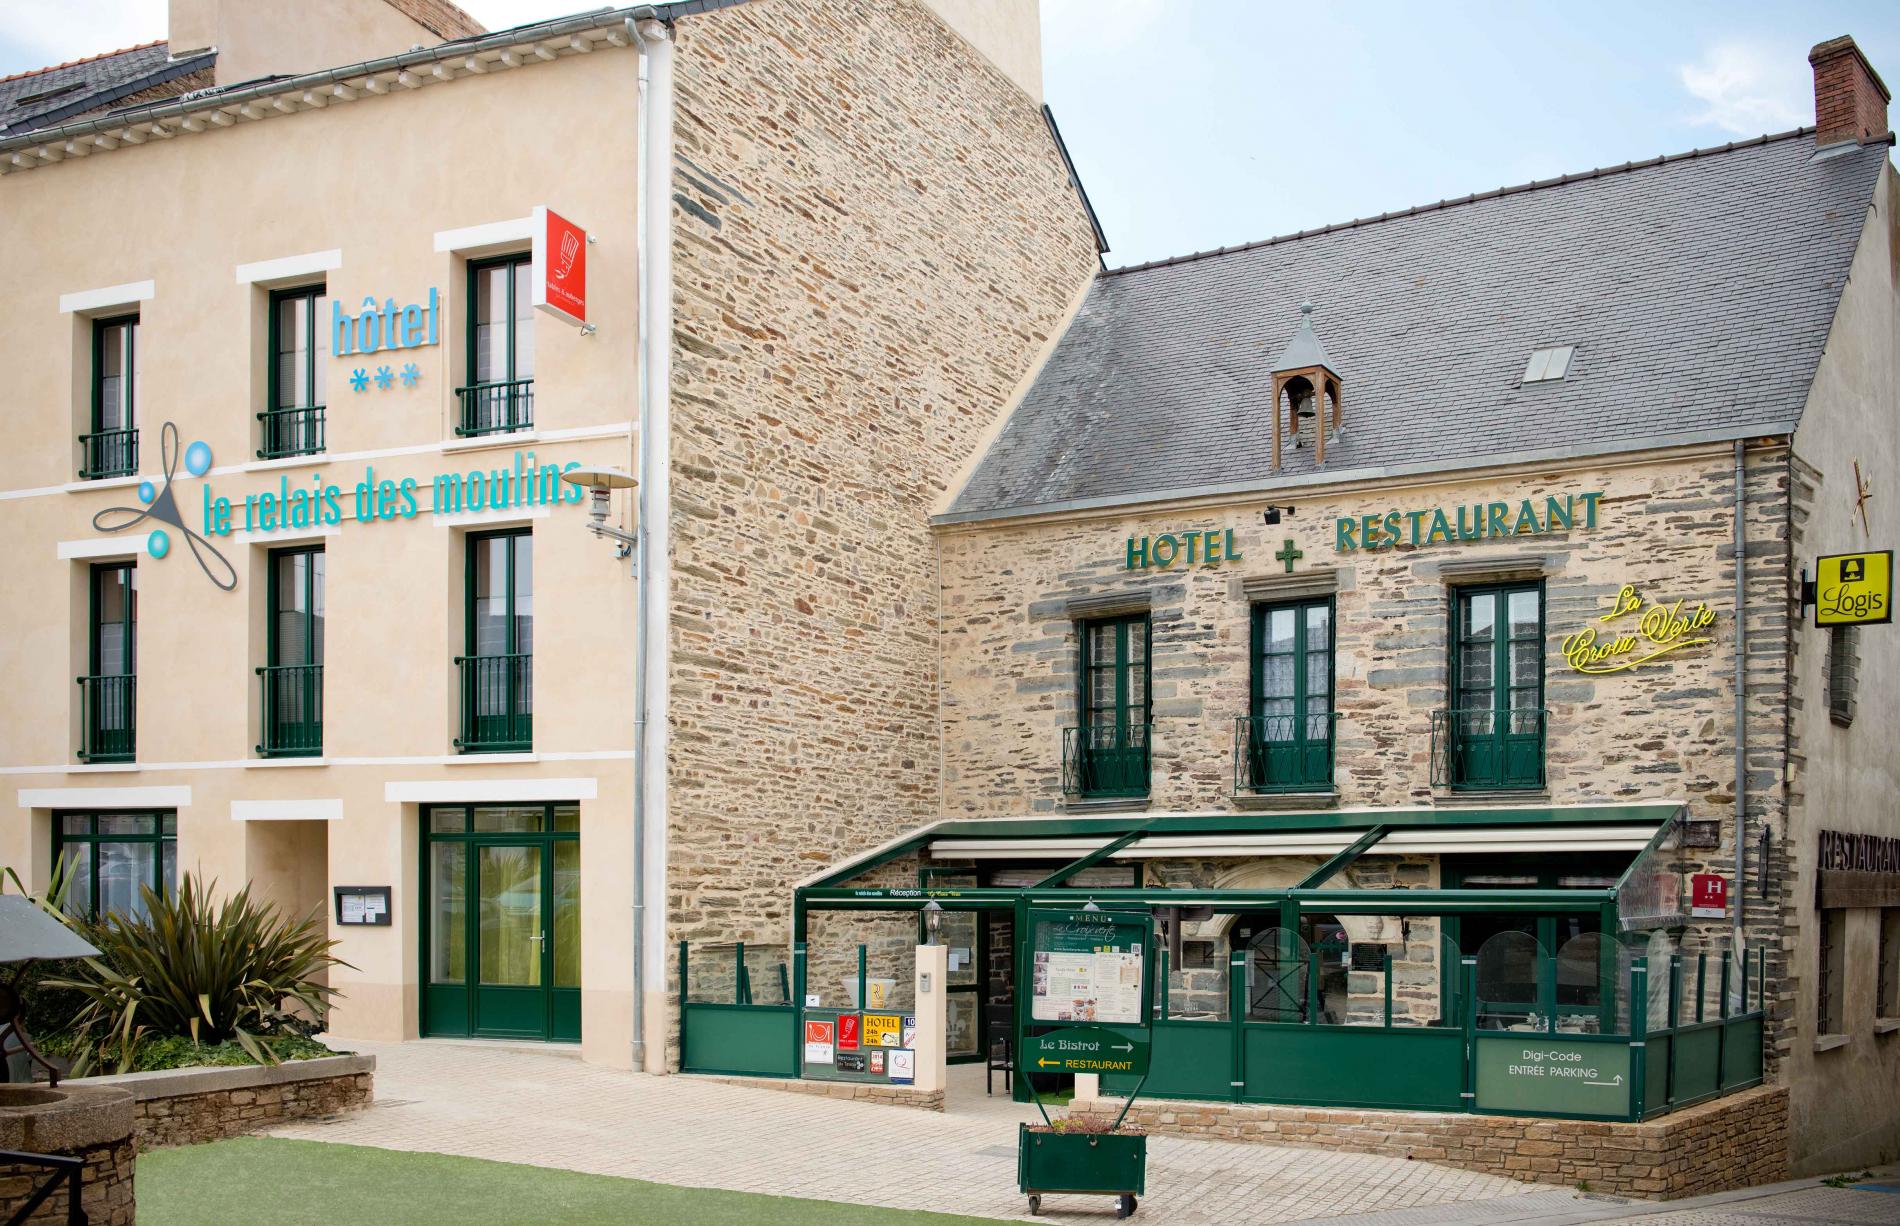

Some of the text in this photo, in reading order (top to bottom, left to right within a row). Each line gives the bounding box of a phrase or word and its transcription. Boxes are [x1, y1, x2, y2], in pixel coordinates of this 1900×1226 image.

[332, 287, 438, 357] hôtel
[203, 451, 583, 536] le relais des moulins
[1125, 490, 1605, 569] HOTEL RESTAURANT
[1600, 584, 1643, 622] La
[1820, 583, 1883, 618] Logis
[1562, 598, 1716, 672] Croix Verte
[1819, 830, 1900, 873] RESTAURAN
[889, 889, 921, 898] Réception
[1707, 880, 1722, 894] H
[1075, 914, 1107, 923] MENU
[866, 1017, 897, 1028] HOTEL
[1040, 1040, 1100, 1051] Le Bistrot
[1522, 1050, 1582, 1062] Digi-Code
[1065, 1059, 1132, 1070] RESTAURANT
[1509, 1064, 1598, 1079] ENTRÉE PARKING
